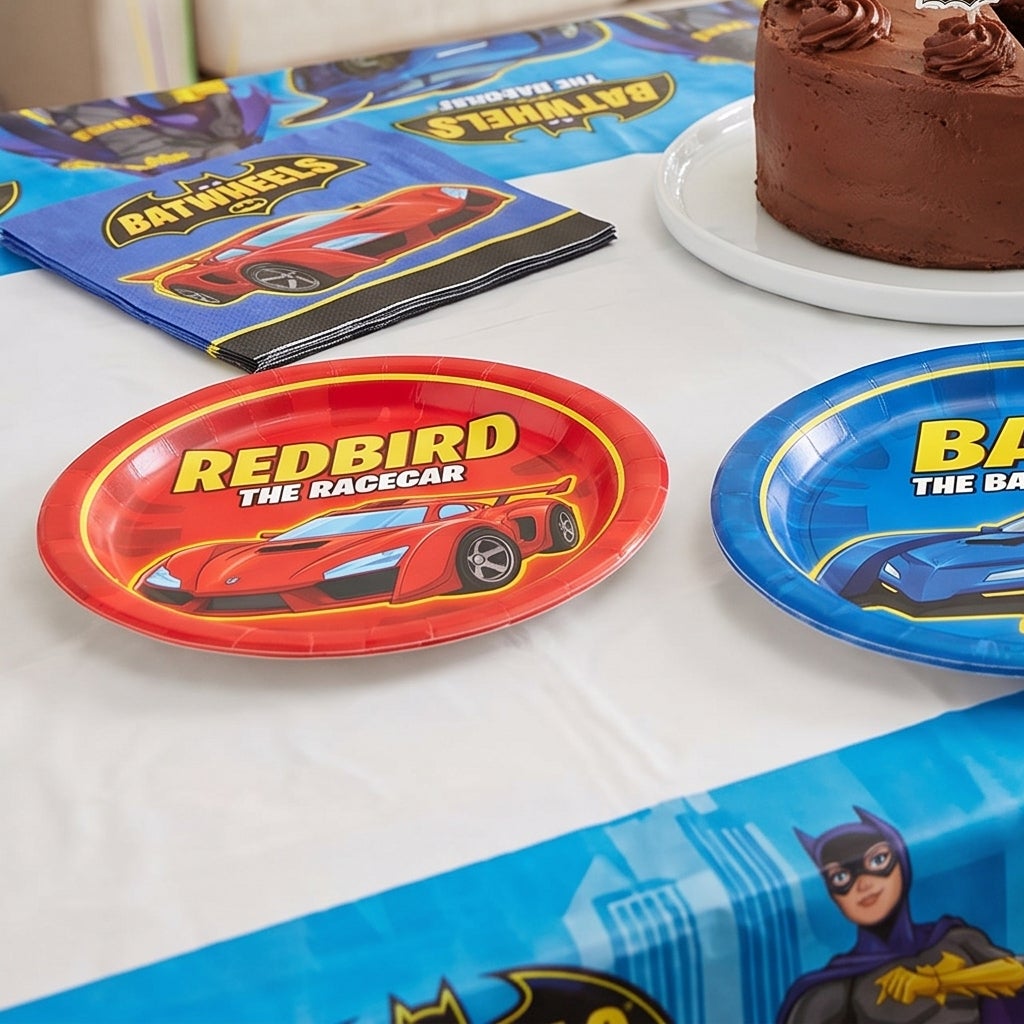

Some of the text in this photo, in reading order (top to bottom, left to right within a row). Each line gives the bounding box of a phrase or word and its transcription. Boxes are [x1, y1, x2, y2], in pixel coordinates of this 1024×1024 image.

[117, 157, 340, 236] BATWHEELS
[172, 413, 518, 494] REDBIRD
[238, 464, 465, 507] THE RACECAR
[912, 474, 975, 496] THE
